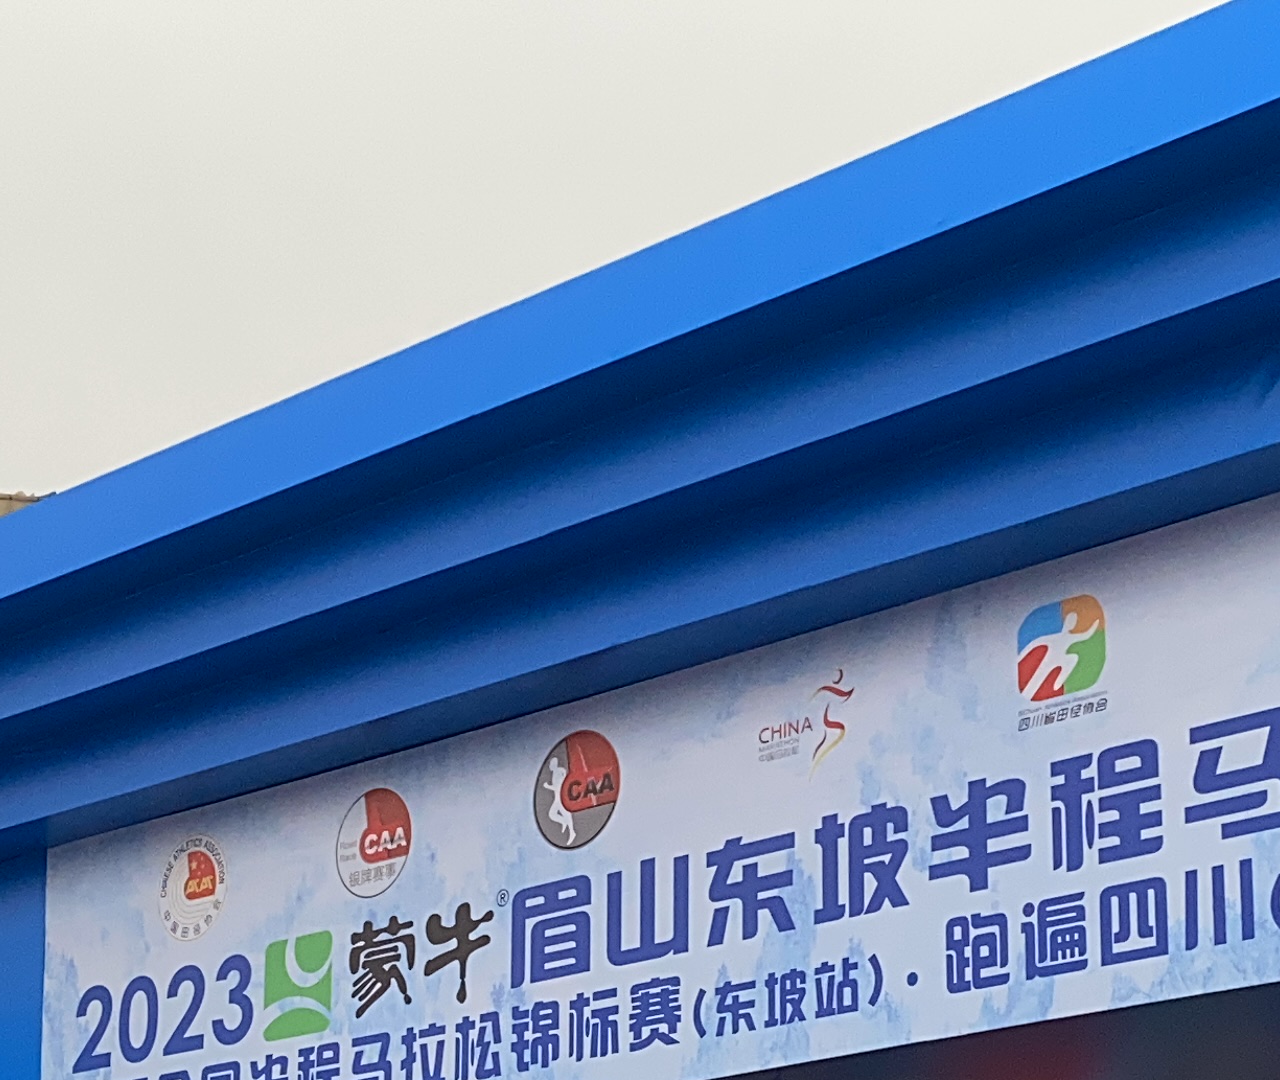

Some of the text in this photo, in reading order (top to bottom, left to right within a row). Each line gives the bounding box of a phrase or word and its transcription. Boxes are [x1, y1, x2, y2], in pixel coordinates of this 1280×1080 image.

[759, 716, 813, 743] CHINA
[568, 771, 615, 801] CAA
[364, 827, 407, 854] CAA
[72, 954, 254, 1074] 2023
[349, 902, 494, 1018] 蒙牛
